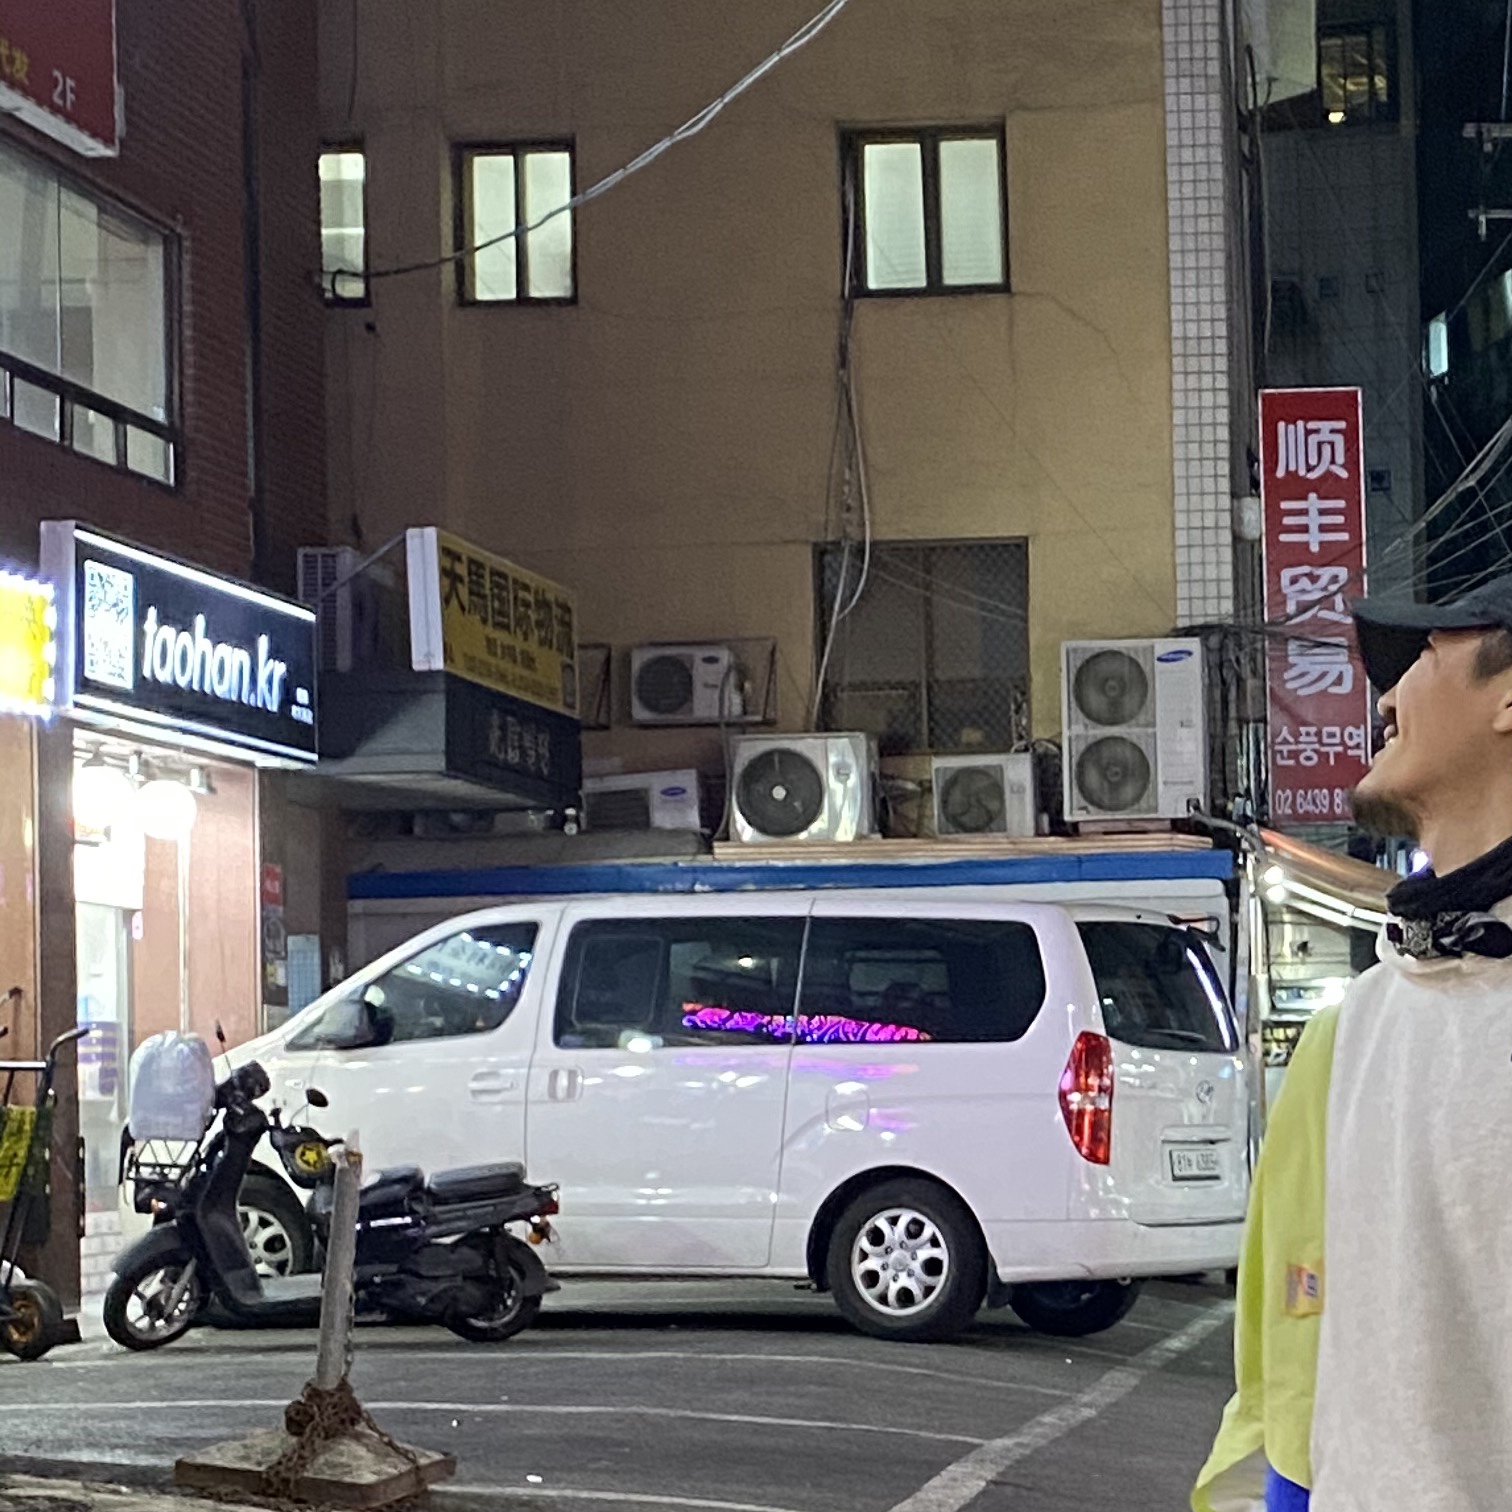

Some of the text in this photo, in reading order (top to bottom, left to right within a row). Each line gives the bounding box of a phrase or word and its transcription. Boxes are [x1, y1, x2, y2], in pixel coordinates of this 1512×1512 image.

[52, 69, 76, 111] 2F
[1275, 419, 1354, 696] 顺丰贸易
[143, 605, 287, 713] taohan.kr
[1274, 724, 1366, 766] 순풍무역
[1275, 789, 1293, 815] 02
[1296, 788, 1330, 815] 6439
